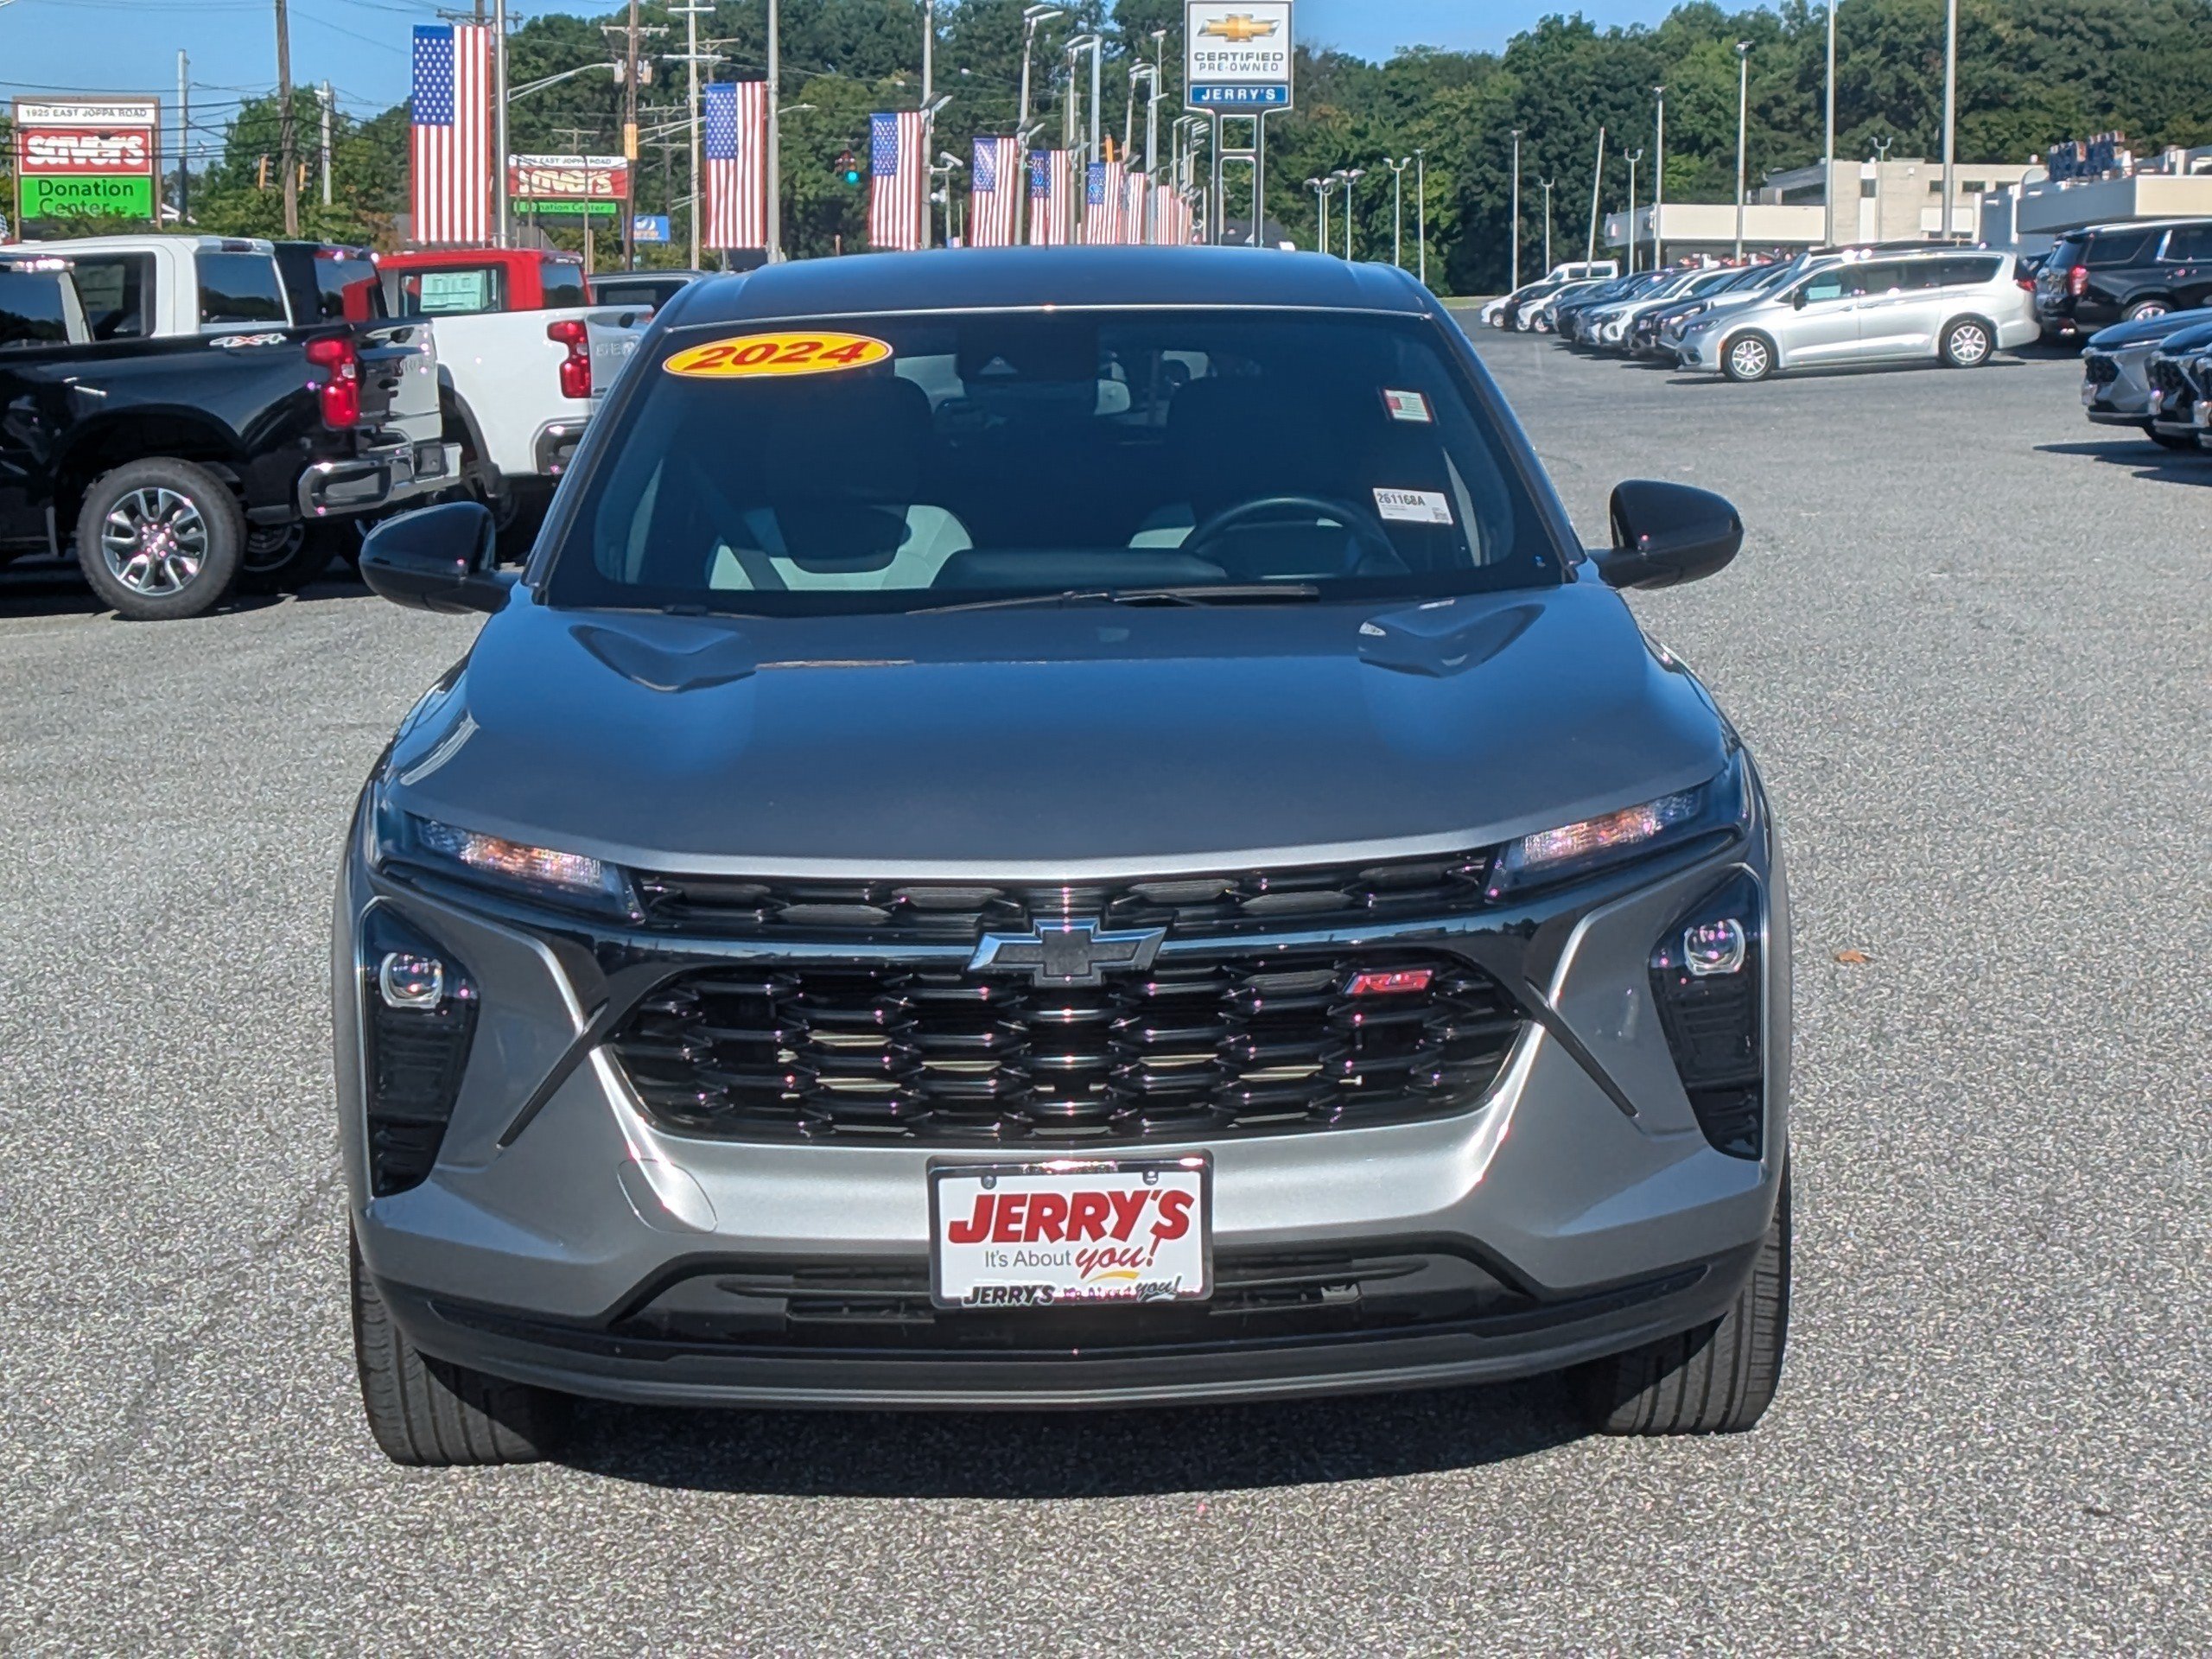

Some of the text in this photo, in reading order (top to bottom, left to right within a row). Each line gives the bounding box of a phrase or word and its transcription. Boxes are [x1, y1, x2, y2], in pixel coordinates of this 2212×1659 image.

[1193, 52, 1284, 61] CERTIFIED
[1198, 62, 1279, 71] PRE-OWNED
[1201, 88, 1276, 100] JERRY'S
[53, 109, 79, 118] EAST
[82, 109, 116, 118] JOPPA
[118, 109, 147, 118] ROAD
[37, 179, 134, 197] Donation
[38, 197, 111, 215] Center
[683, 340, 872, 371] 2024
[1376, 493, 1426, 506] 261168A
[1349, 969, 1433, 994] RS
[948, 1189, 1196, 1244] JERRY'S
[984, 1236, 1161, 1280] It's About you!
[963, 1284, 1057, 1306] JERRY'S
[1135, 1274, 1183, 1302] you!
